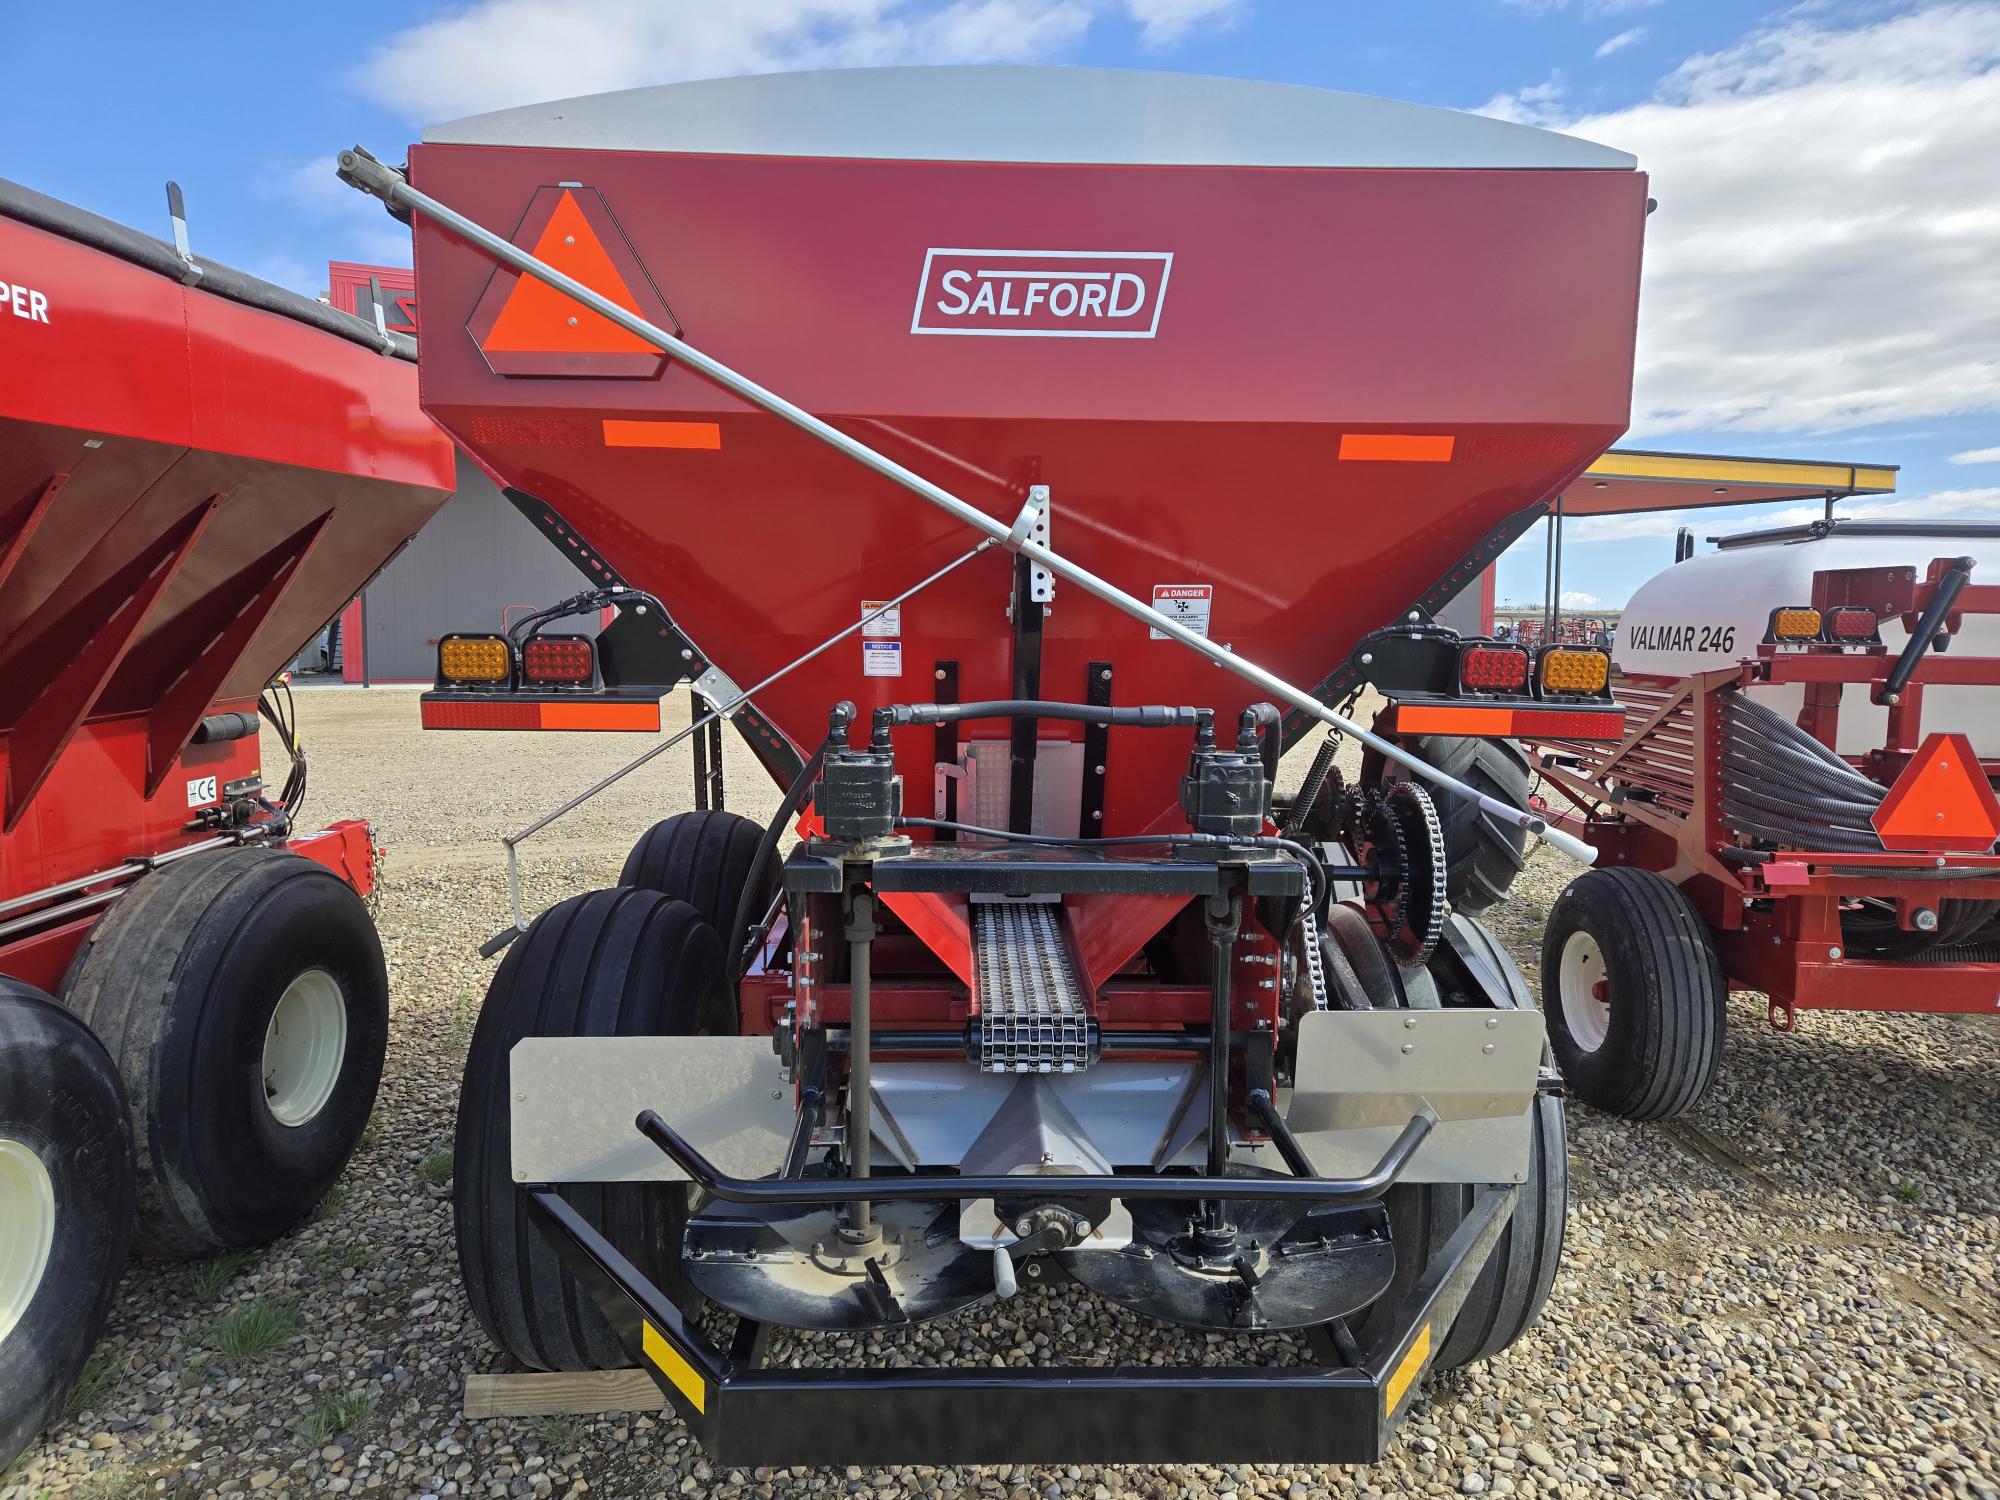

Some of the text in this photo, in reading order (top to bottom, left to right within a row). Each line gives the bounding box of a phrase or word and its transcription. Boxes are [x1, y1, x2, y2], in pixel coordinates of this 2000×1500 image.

[936, 269, 1146, 318] SALFORD
[1171, 589, 1204, 597] DANGER
[1630, 625, 1736, 654] VALMAR 246
[198, 779, 215, 800] CE
